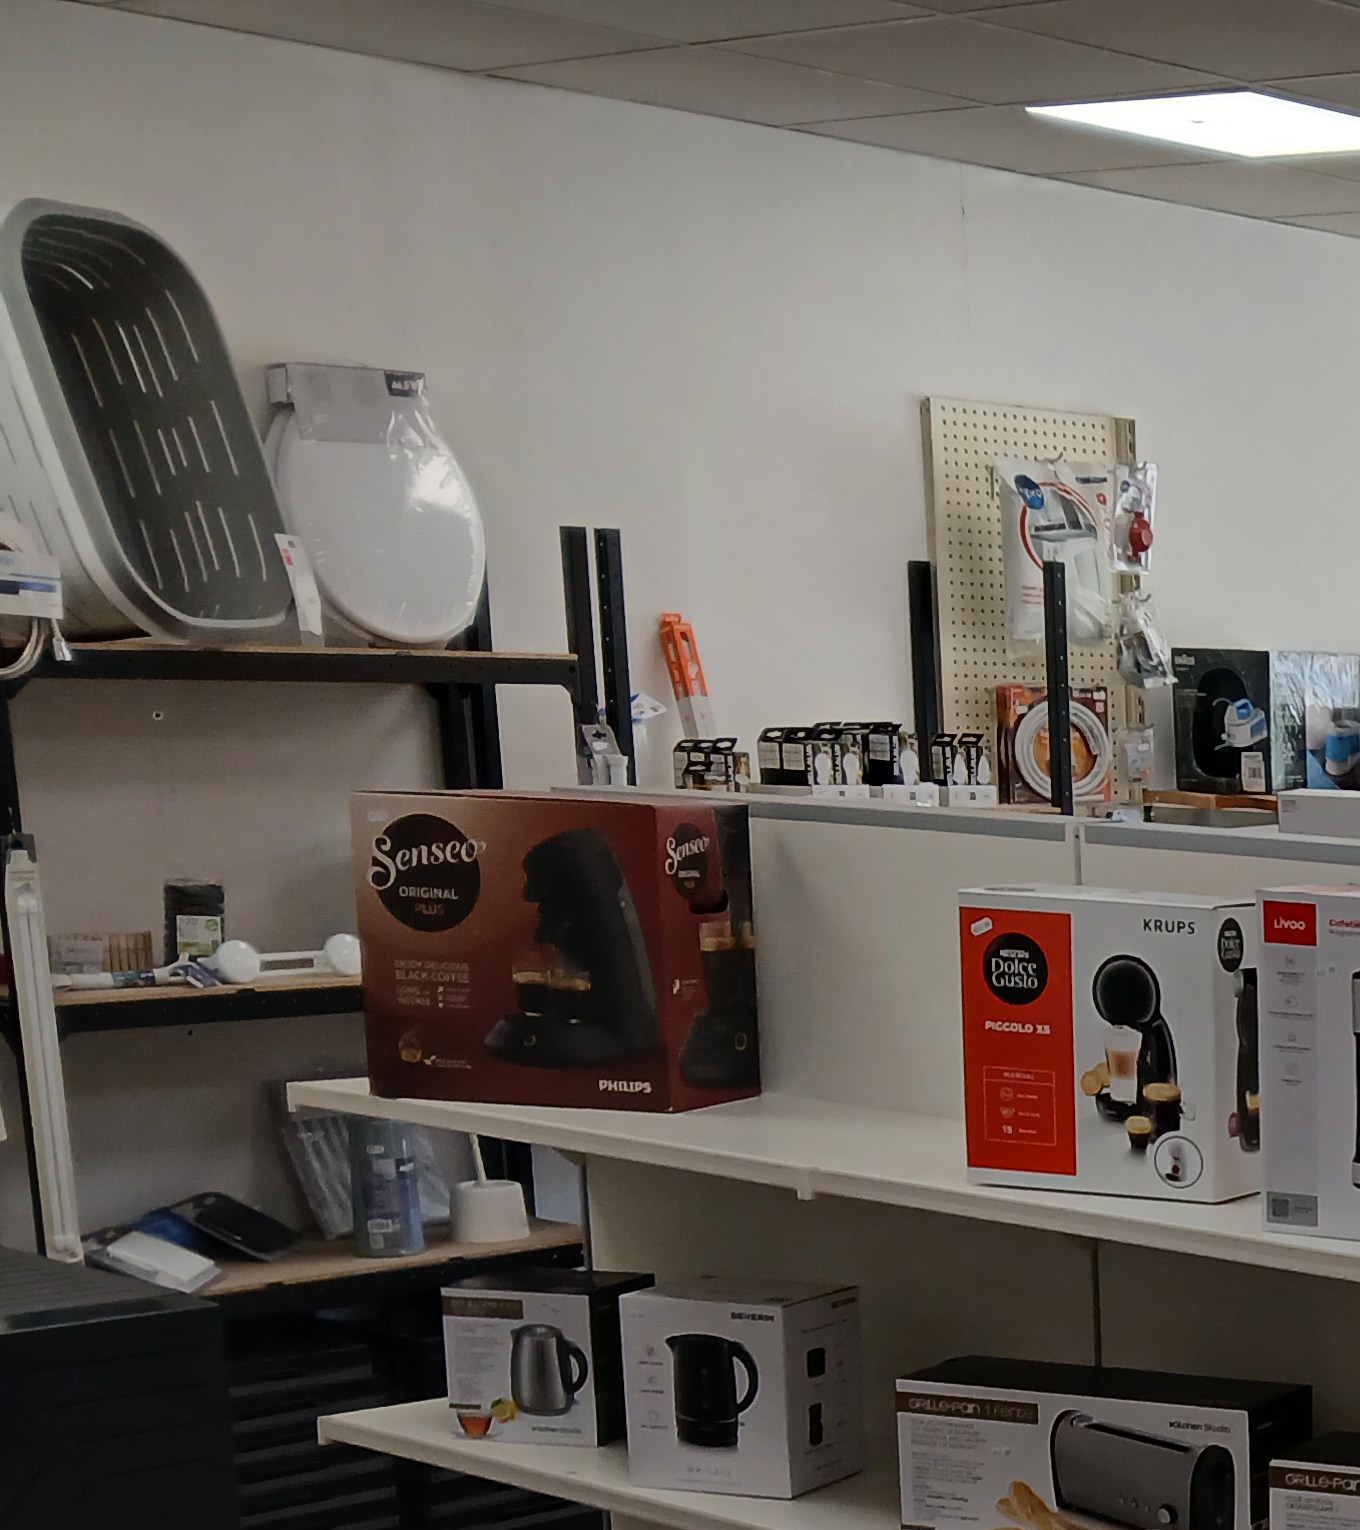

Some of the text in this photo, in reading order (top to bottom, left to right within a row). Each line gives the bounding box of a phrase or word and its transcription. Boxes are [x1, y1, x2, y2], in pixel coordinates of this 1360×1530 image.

[367, 835, 486, 890] Senseo
[399, 886, 458, 900] ORIGINAL
[1142, 919, 1196, 935] KRUPS
[991, 958, 1037, 976] Dolce
[991, 971, 1038, 989] Gusto
[985, 1020, 1034, 1034] PICCOLO
[598, 1079, 652, 1093] PHILIPS
